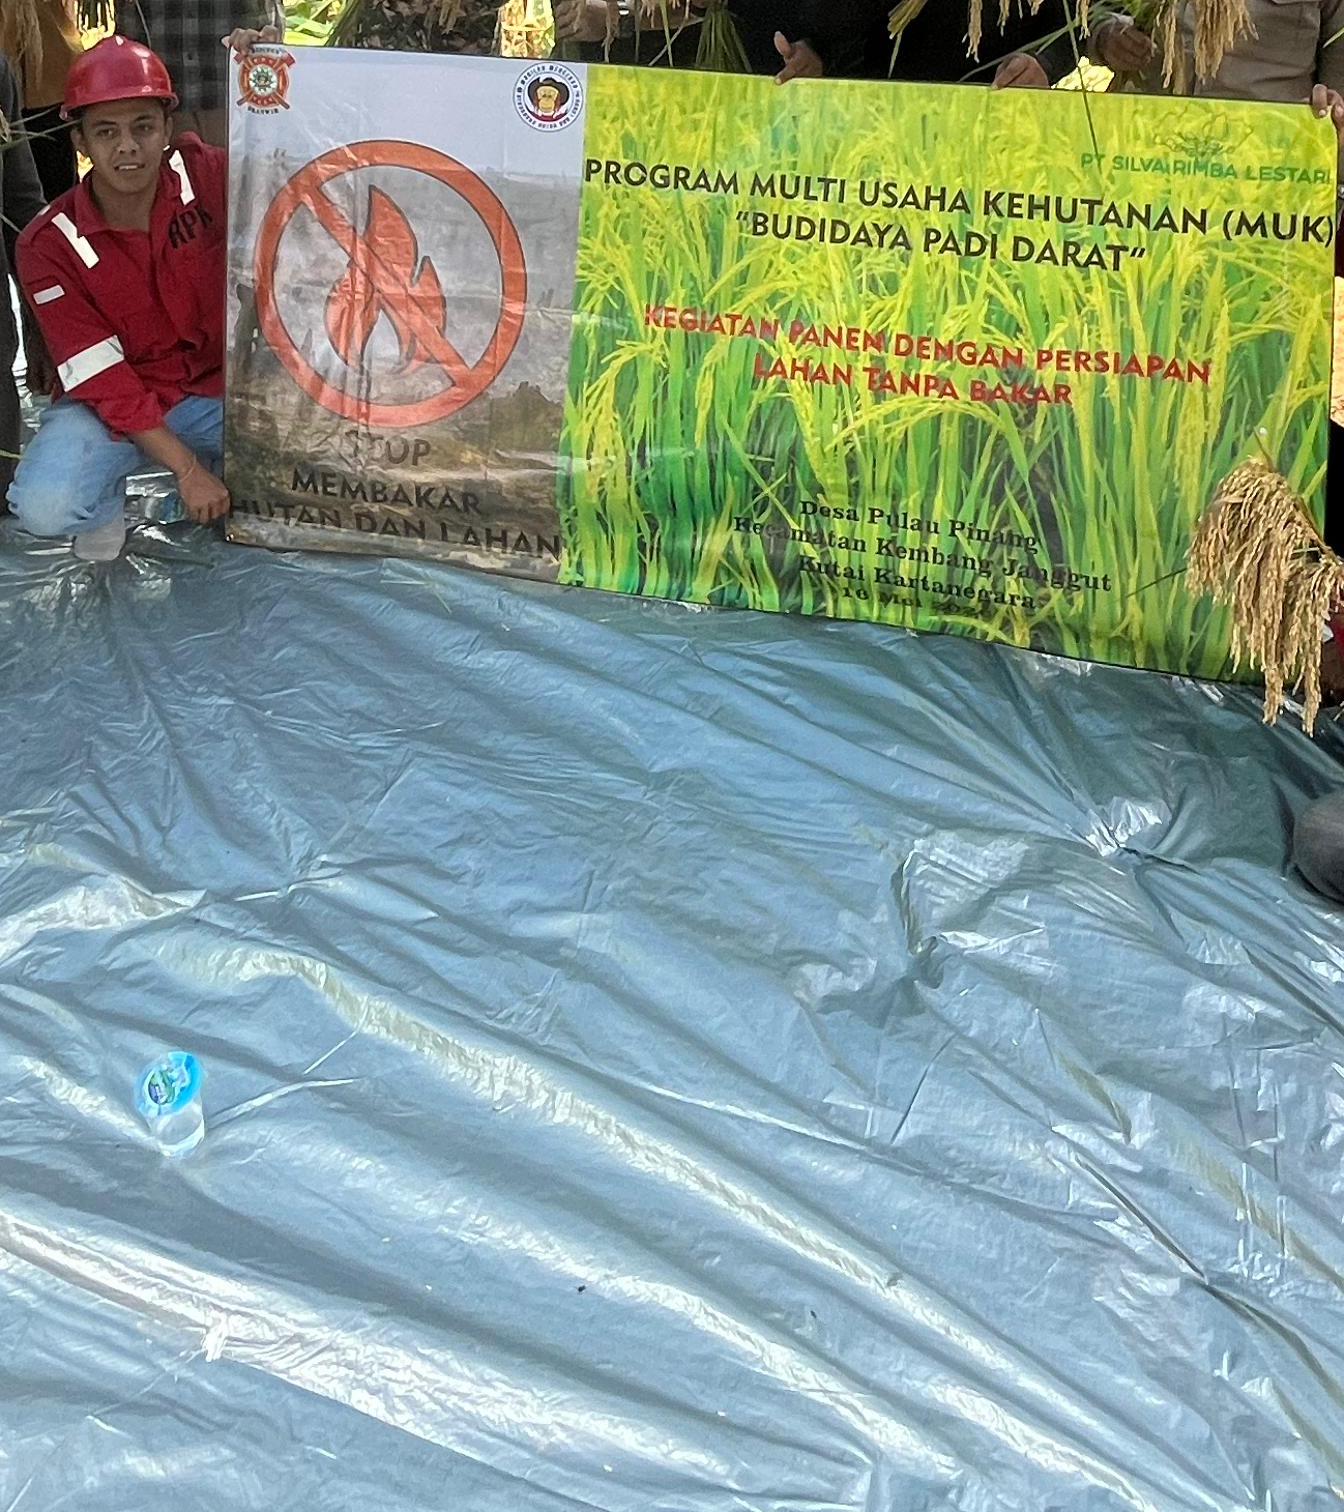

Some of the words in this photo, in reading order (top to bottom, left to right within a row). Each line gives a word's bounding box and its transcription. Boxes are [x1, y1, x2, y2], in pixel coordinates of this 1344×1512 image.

[1080, 152, 1106, 169] PT
[1112, 155, 1168, 174] SILVA
[1172, 159, 1239, 180] RIMBA
[1245, 165, 1333, 186] LESTARI
[584, 158, 739, 196] PROGRAM
[749, 173, 847, 204] MULTI
[858, 180, 971, 215] USAHA
[982, 189, 1208, 236] KEHUTANAN
[1222, 209, 1334, 247] (MUK)
[923, 226, 998, 261] PADI
[644, 304, 780, 340] KEGIATAN
[788, 320, 886, 354] PANEN
[893, 333, 1024, 370] DENGAN
[1035, 348, 1210, 385] PERSIAPAN
[752, 352, 854, 388] LAHAN
[861, 366, 960, 402] TANPA
[969, 379, 1074, 406] BAKAR
[345, 428, 431, 467] STOP
[290, 467, 482, 516] MEMBAKAR
[356, 512, 426, 542] DAN
[799, 500, 860, 522] Desa
[867, 507, 940, 535] Pulau
[948, 519, 1040, 556] Pinang
[799, 554, 865, 582] Kutai
[873, 566, 1036, 610] Kartanegara
[875, 536, 994, 579] Kembang
